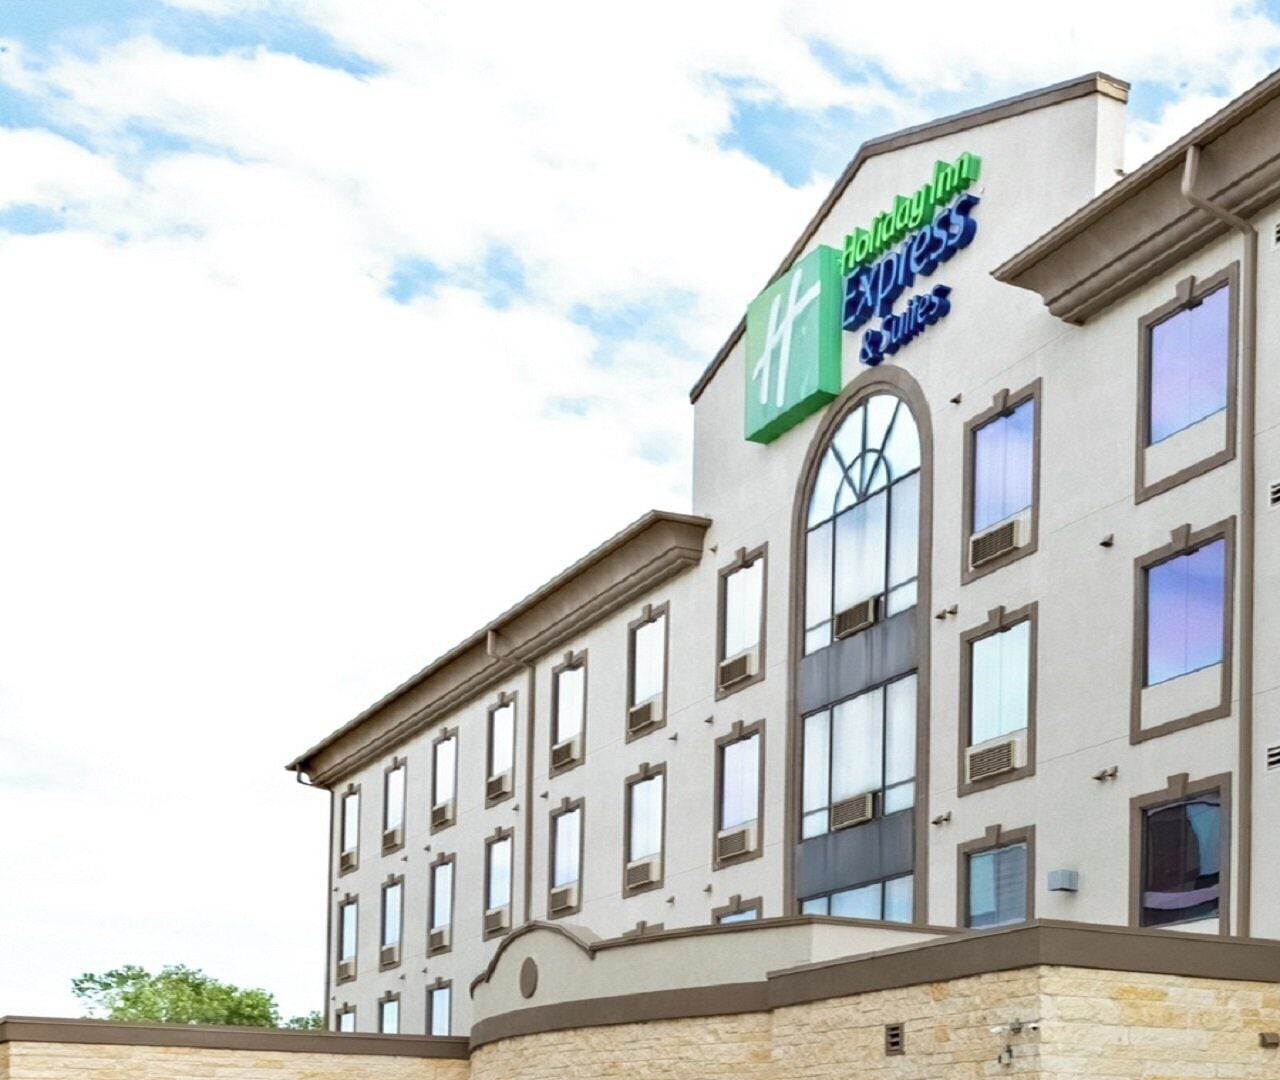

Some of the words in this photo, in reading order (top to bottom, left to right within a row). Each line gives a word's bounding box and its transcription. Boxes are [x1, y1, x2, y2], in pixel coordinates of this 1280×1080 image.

[841, 184, 932, 276] Holiday
[929, 152, 981, 205] Inn
[842, 194, 979, 331] Express
